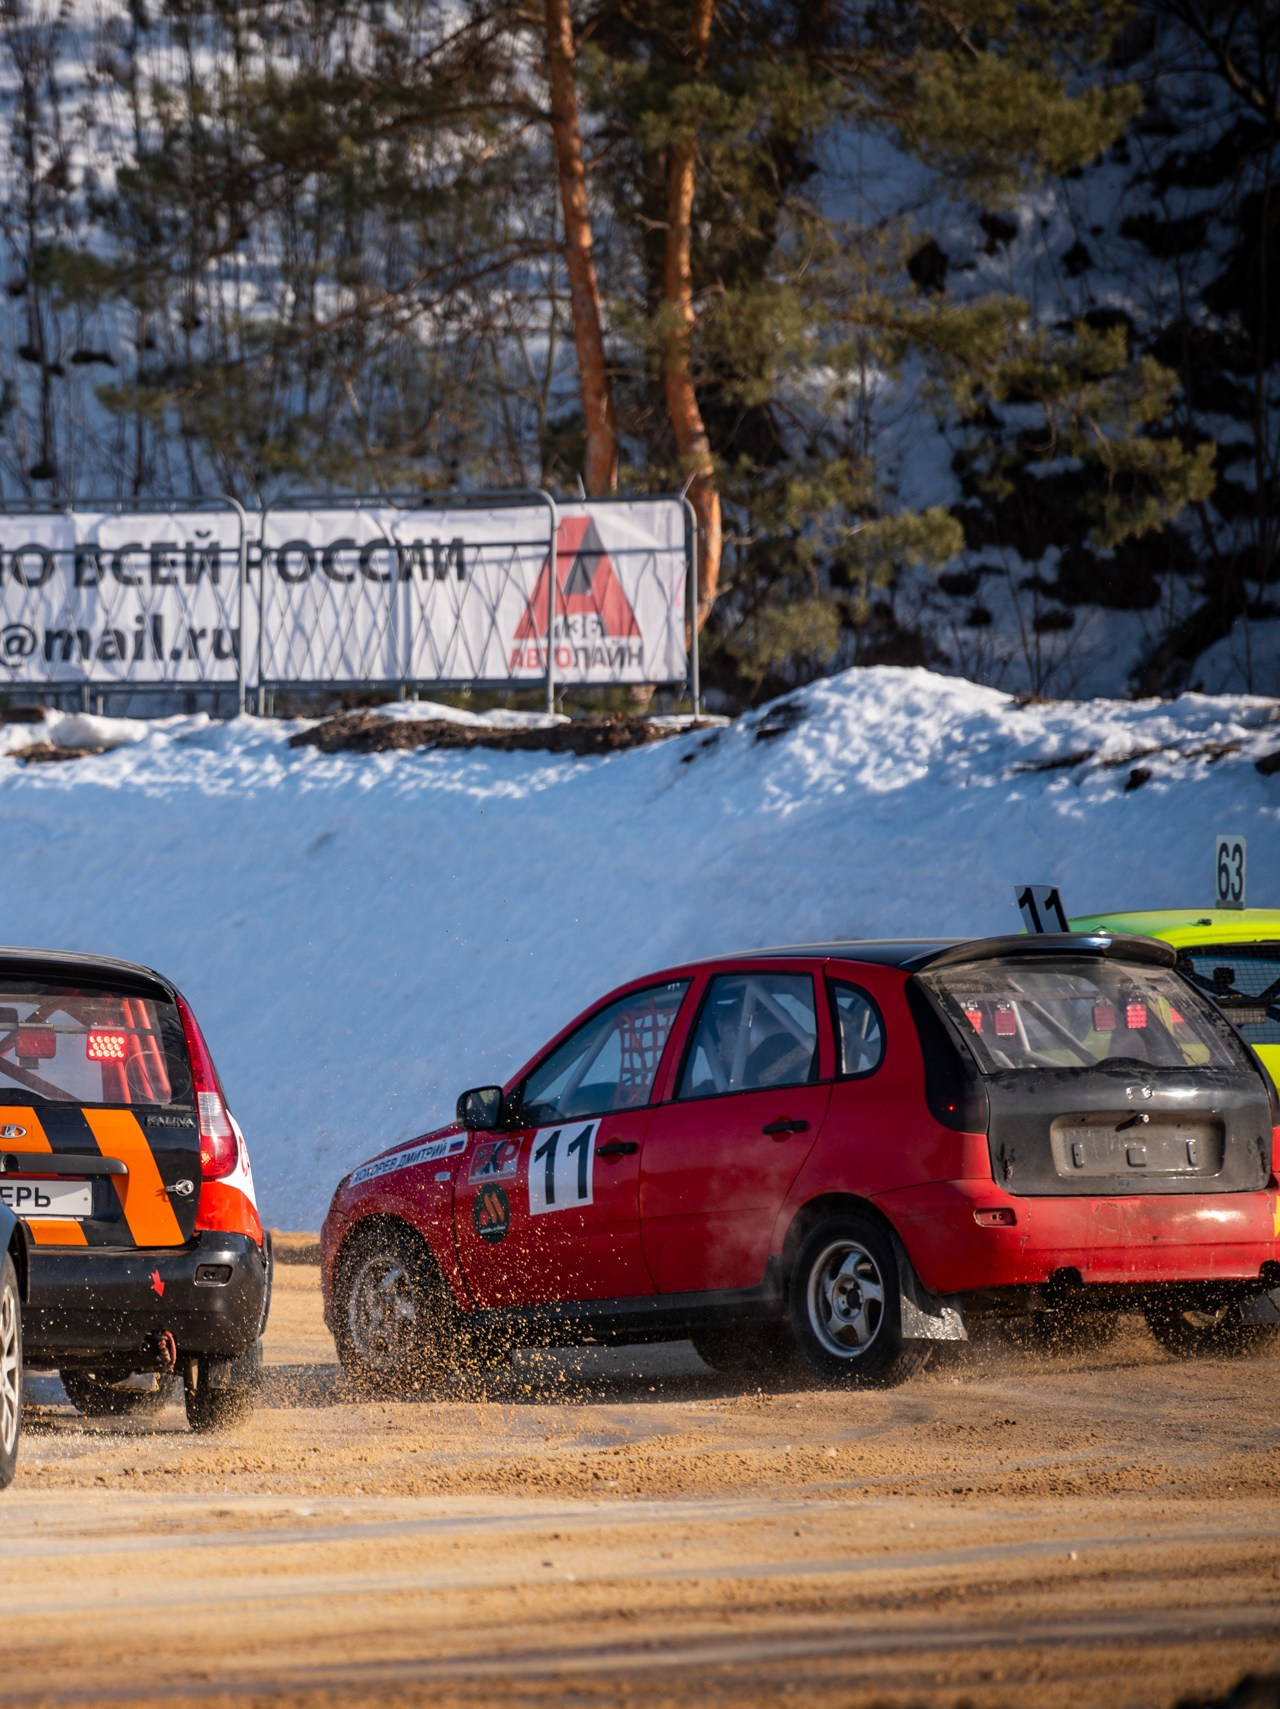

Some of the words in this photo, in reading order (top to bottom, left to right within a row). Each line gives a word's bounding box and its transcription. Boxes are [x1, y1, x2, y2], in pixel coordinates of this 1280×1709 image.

[74, 529, 220, 587] ВСЕЙ
[1217, 841, 1244, 902] 63
[1017, 887, 1070, 934] 11
[144, 1114, 196, 1129] KALINA
[396, 1139, 448, 1169] ДМИТРИЙ
[534, 1123, 596, 1205] 11
